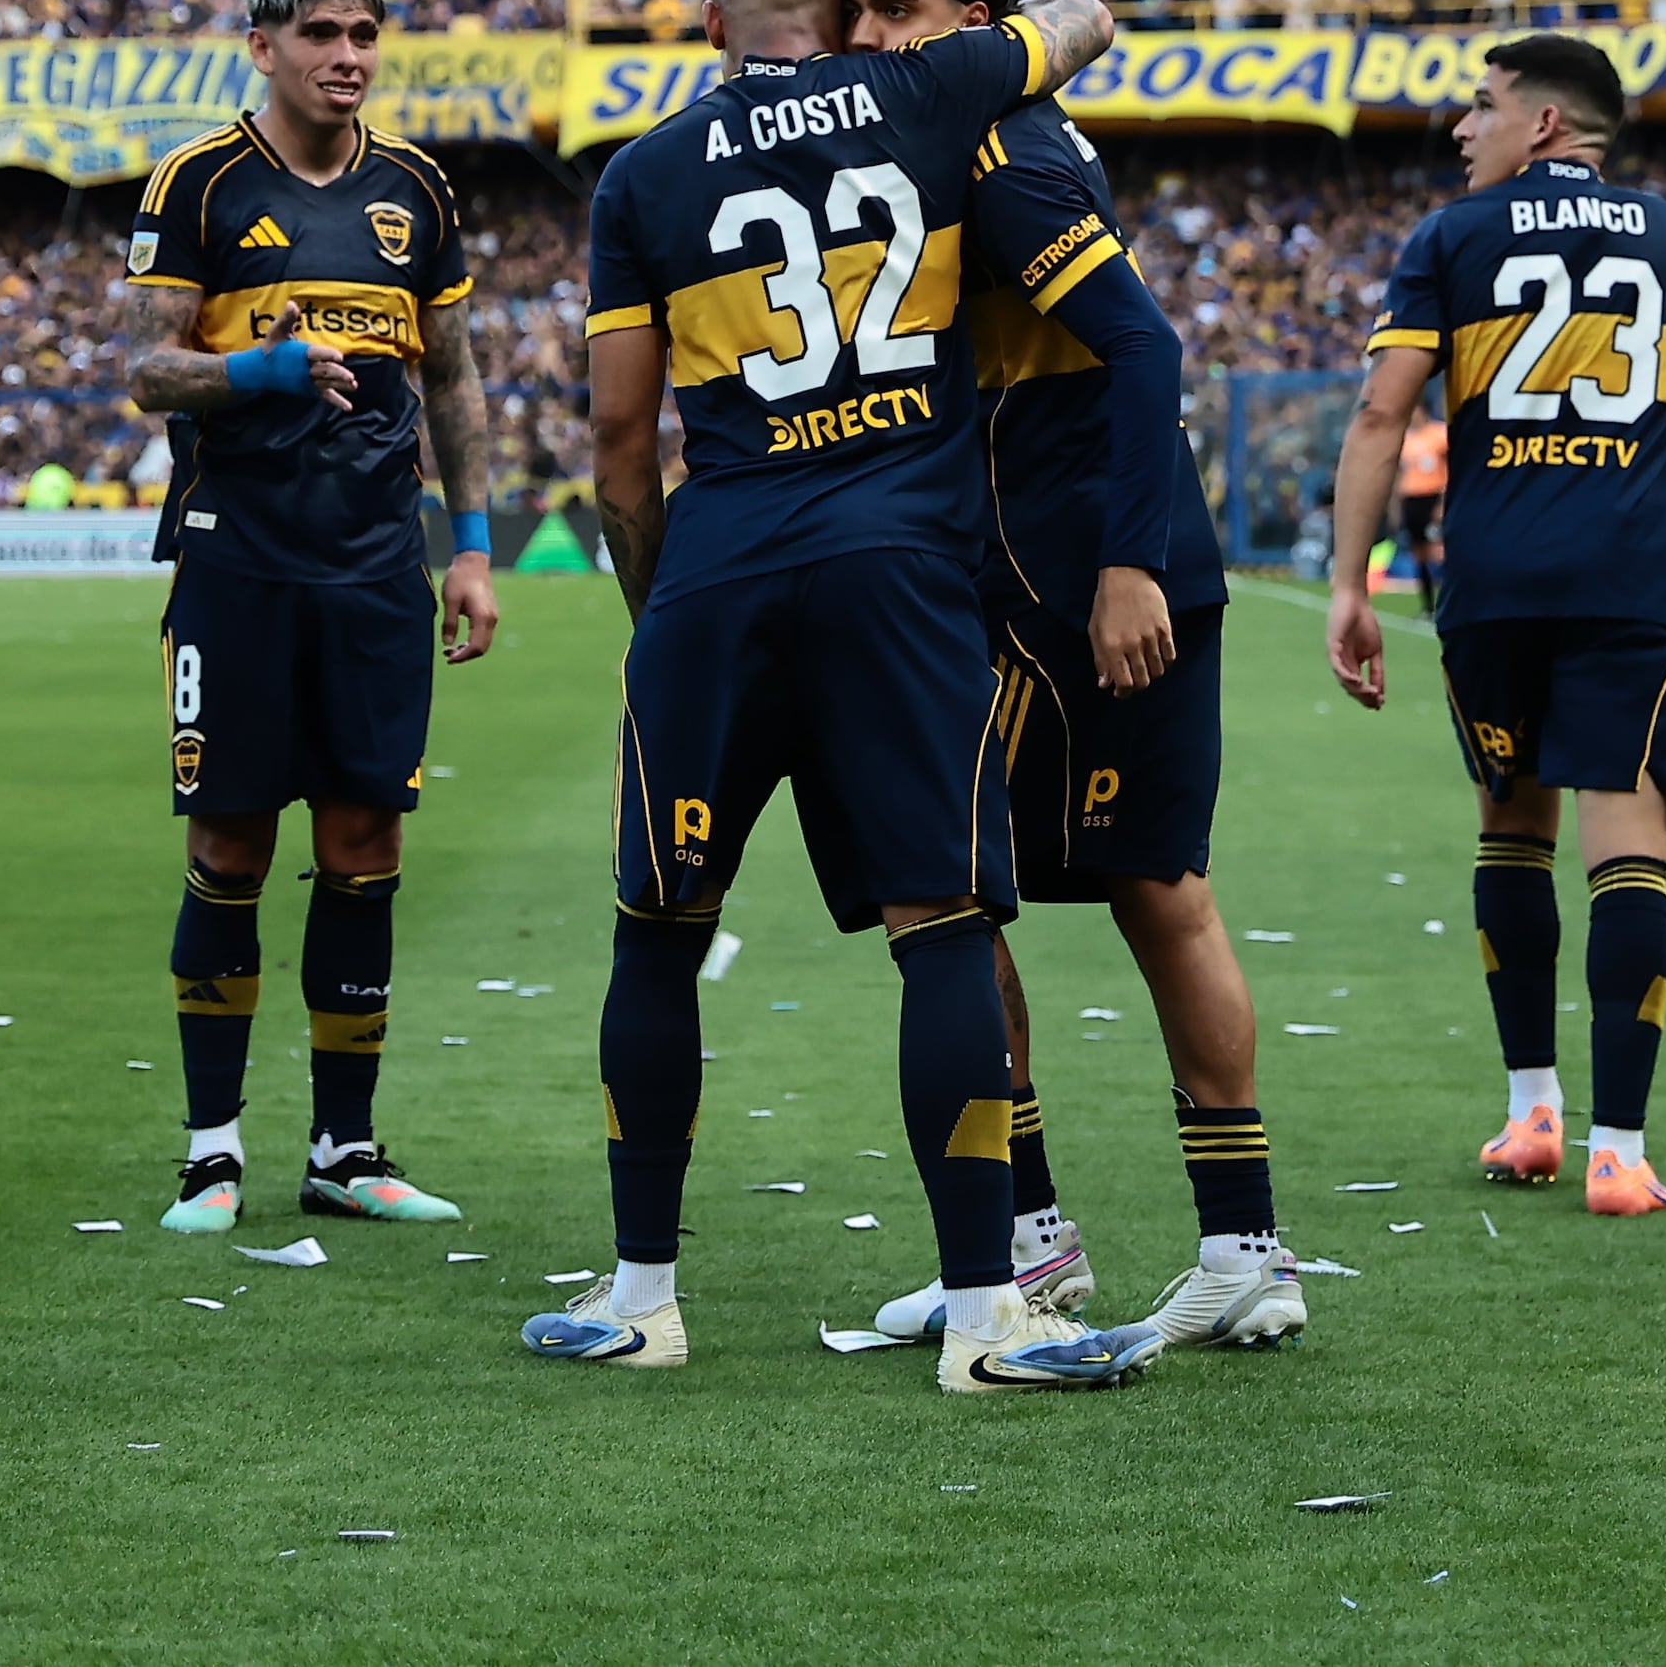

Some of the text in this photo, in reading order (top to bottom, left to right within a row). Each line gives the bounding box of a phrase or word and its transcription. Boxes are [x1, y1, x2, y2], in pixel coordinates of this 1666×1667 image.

[744, 63, 797, 77] 1905
[1067, 38, 1334, 102] BOCA
[705, 83, 883, 162] A. COSTA
[1020, 212, 1106, 288] CETROGAR
[1510, 196, 1647, 236] BLANCO
[707, 161, 936, 402] 32
[249, 300, 411, 344] btsson
[1487, 252, 1664, 425] 23
[767, 382, 932, 455] DIRECTV
[1486, 434, 1640, 469] DIRECTV
[174, 644, 202, 724] 8
